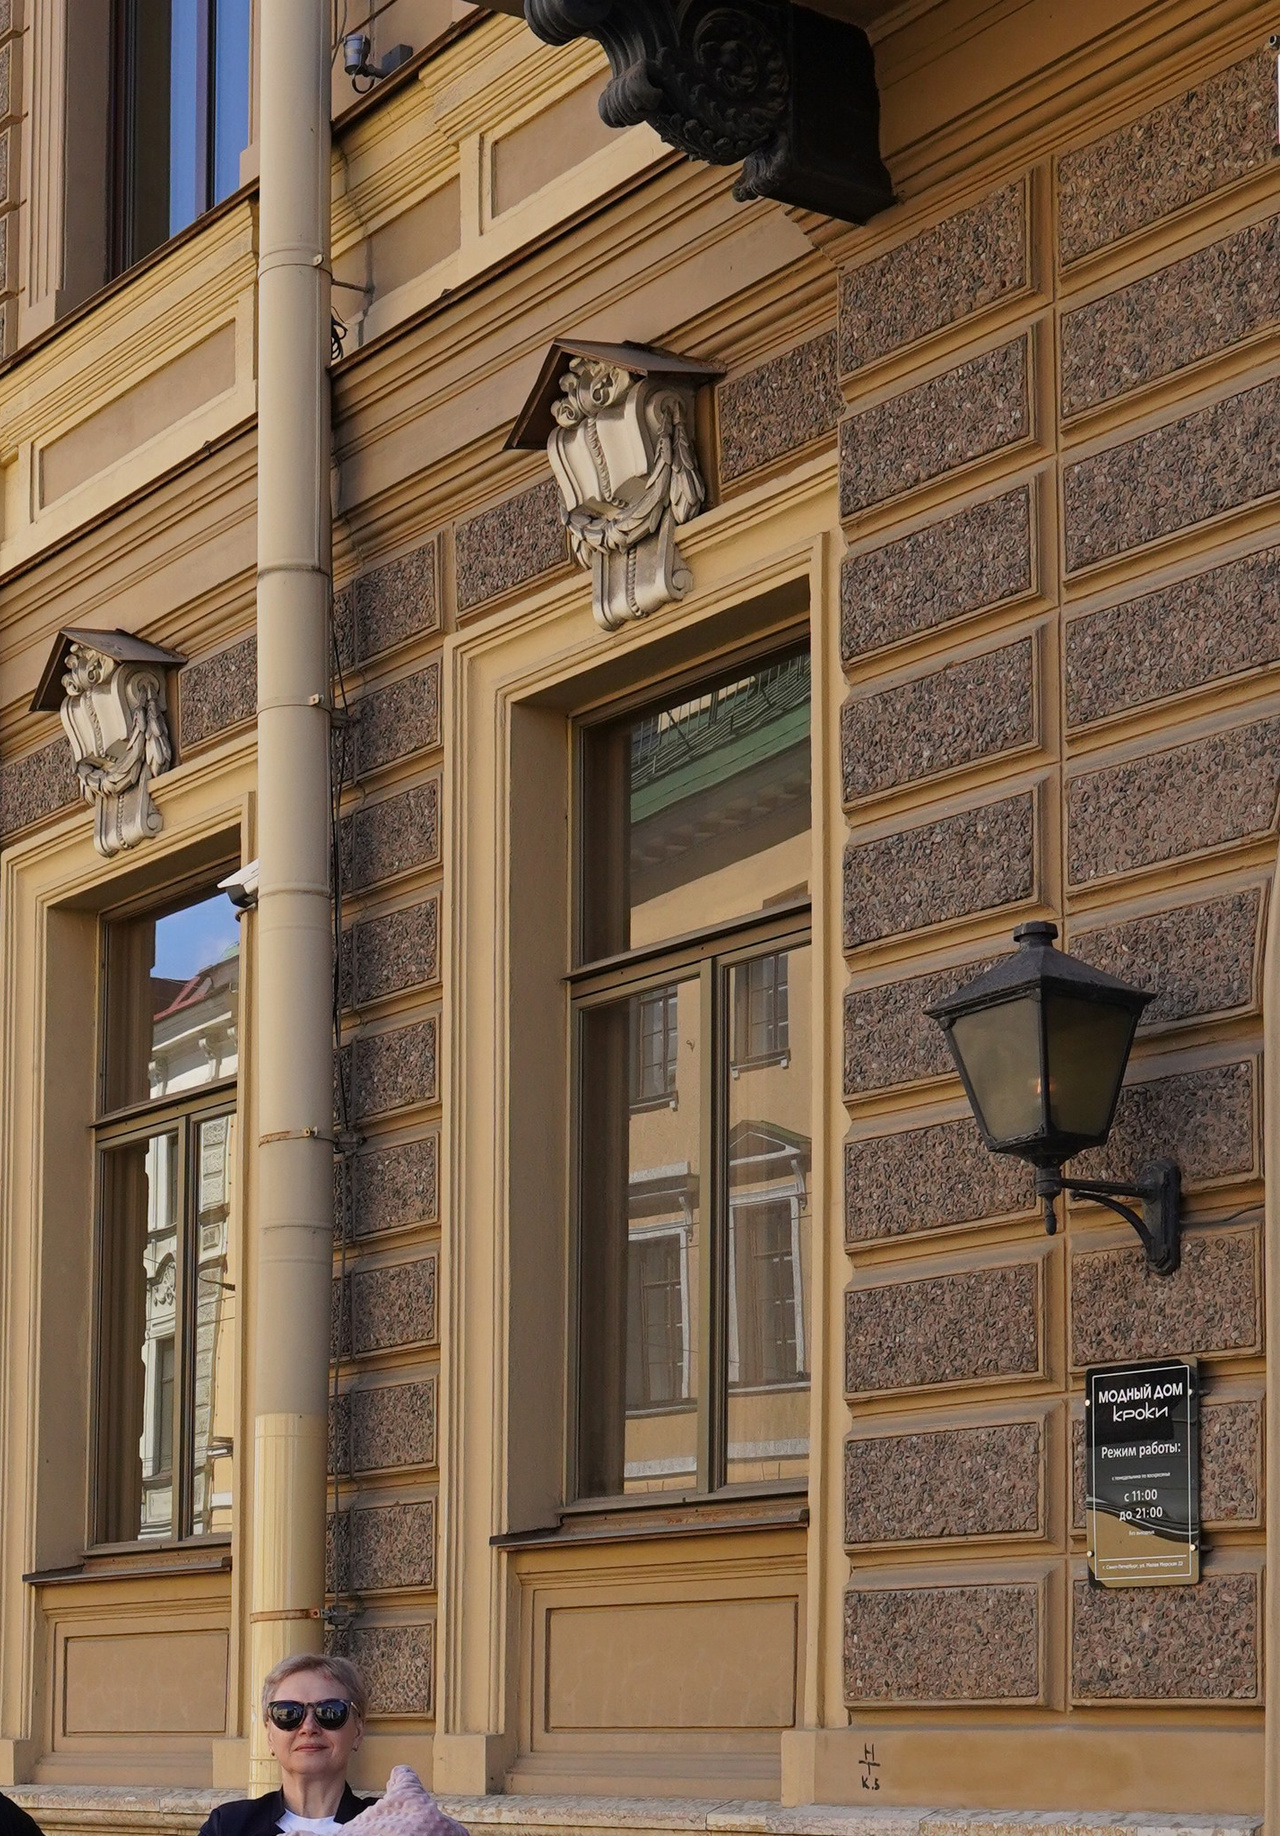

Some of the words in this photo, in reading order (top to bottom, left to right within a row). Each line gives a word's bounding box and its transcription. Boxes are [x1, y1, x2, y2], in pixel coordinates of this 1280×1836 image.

[1098, 1383, 1152, 1404] МОДНЫЙ
[1153, 1382, 1183, 1400] ДОМ
[1101, 1446, 1137, 1459] Режим
[1139, 1441, 1181, 1459] работы:
[1132, 1488, 1158, 1501] 11:00
[1119, 1510, 1133, 1522] до
[1135, 1506, 1163, 1519] 21:00
